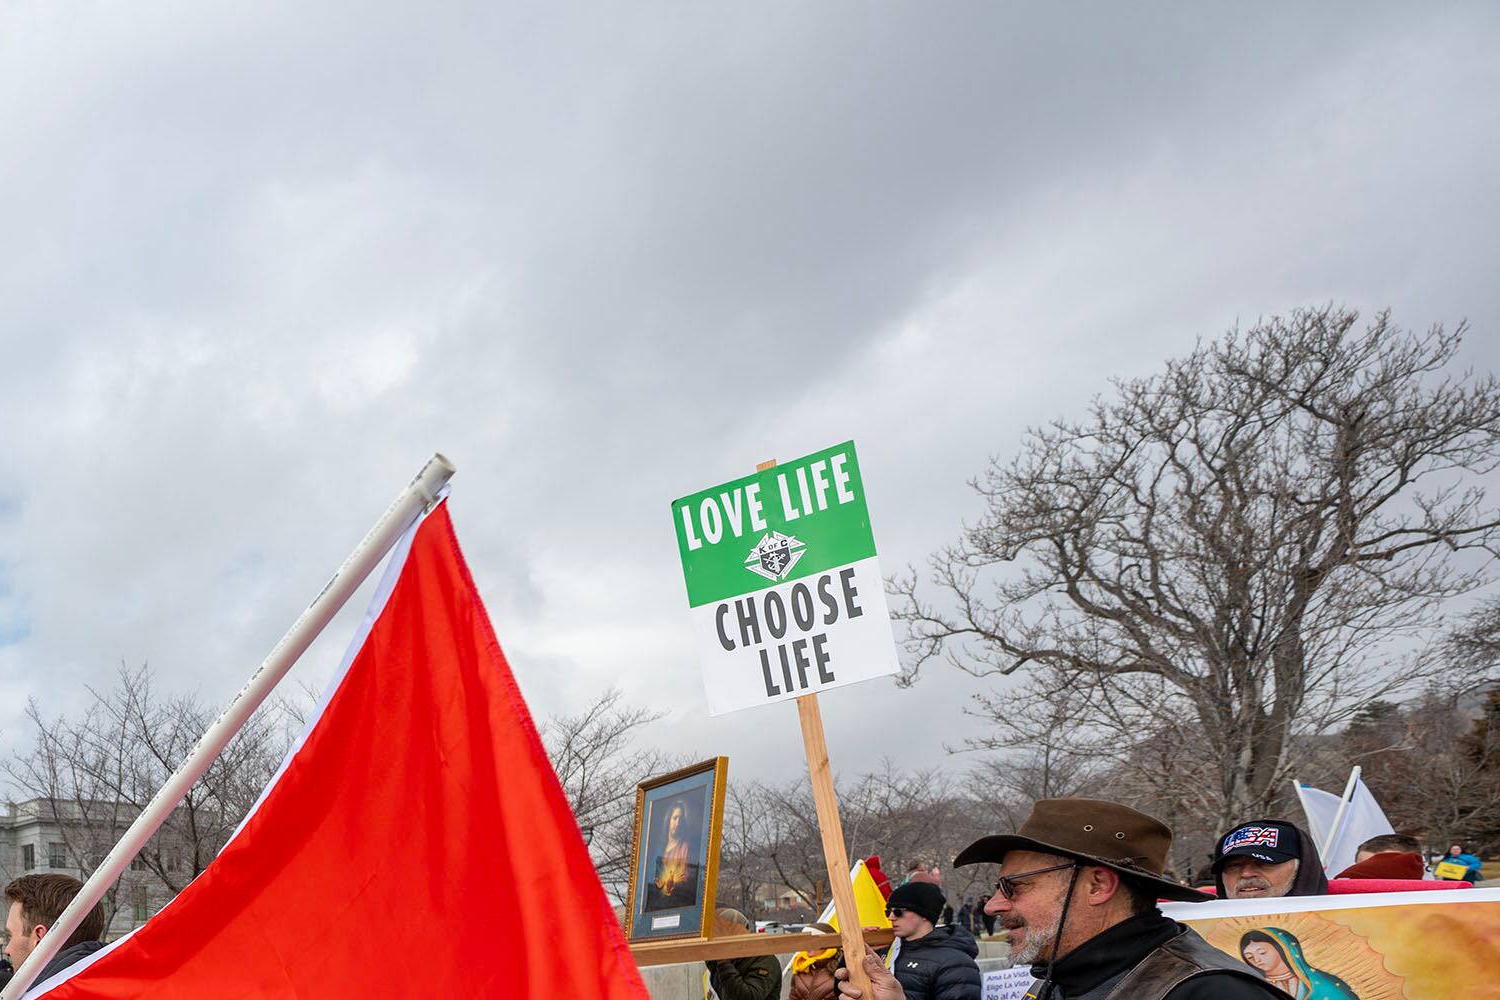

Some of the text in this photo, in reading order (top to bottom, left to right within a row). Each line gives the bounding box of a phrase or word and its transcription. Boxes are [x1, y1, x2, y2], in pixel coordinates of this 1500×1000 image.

[681, 452, 855, 551] LOVE LIFE
[759, 546, 766, 554] K
[781, 539, 788, 547] C
[715, 567, 863, 652] CHOOSE
[759, 633, 835, 697] LIFE
[1222, 826, 1279, 855] USA
[987, 984, 1003, 992] Elige
[1014, 980, 1030, 988] Vida
[1013, 971, 1029, 979] Vida
[1000, 992, 1008, 1000] al
